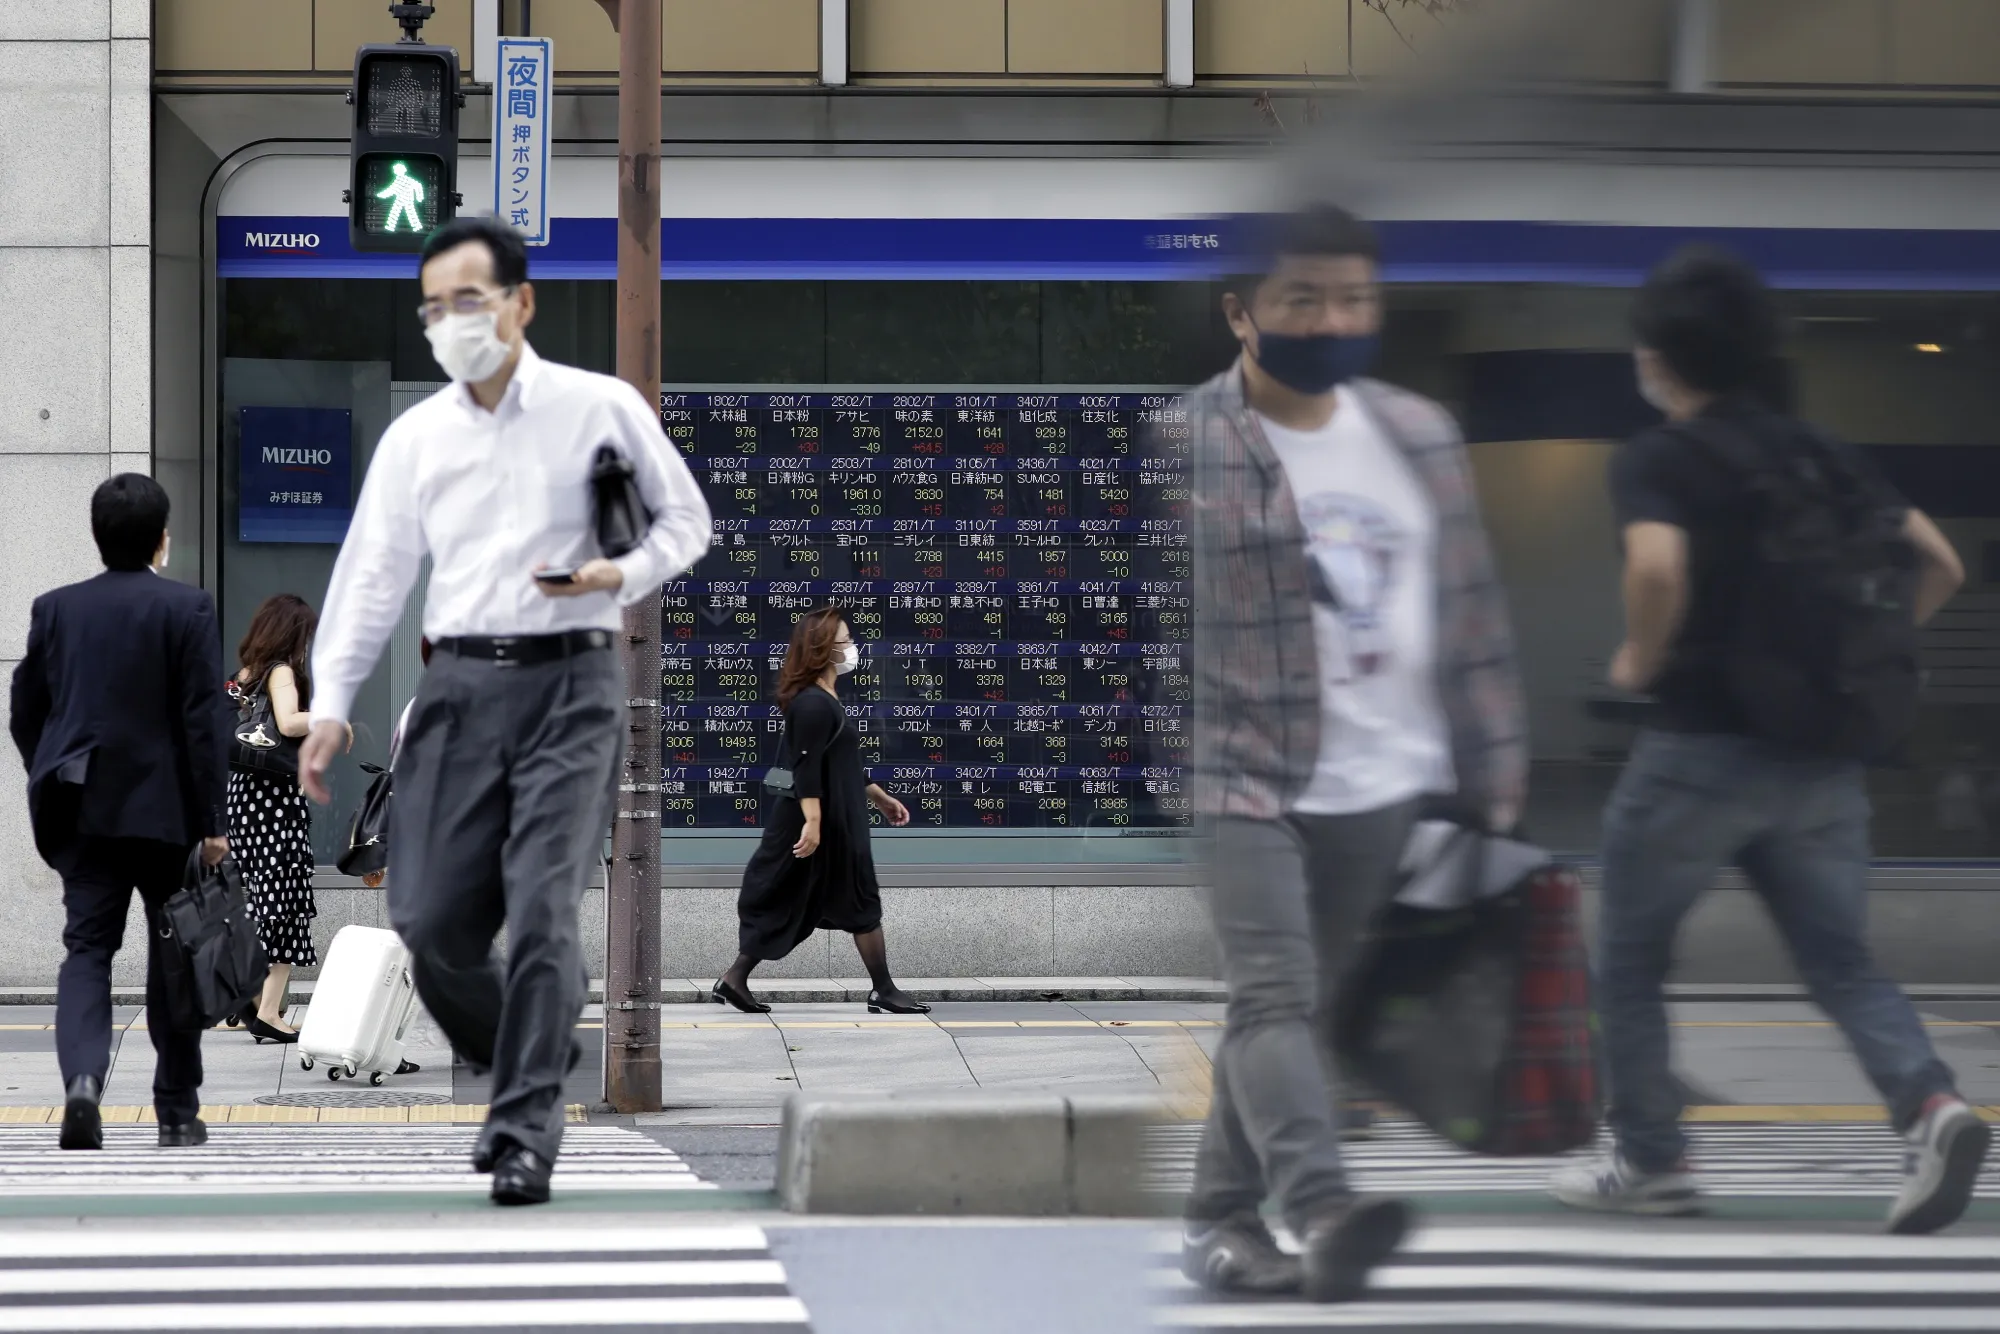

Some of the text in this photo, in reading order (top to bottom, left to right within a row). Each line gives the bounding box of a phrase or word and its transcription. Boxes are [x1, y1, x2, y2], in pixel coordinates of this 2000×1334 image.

[245, 232, 320, 248] MIZUHO
[707, 395, 749, 406] 1802/T
[769, 395, 811, 406] 2001/T
[831, 395, 873, 406] 2502/T
[893, 395, 935, 406] 2802/T
[955, 396, 996, 407] 3101/T
[1017, 396, 1058, 407] 3407/T
[1079, 396, 1120, 407] 4005/T
[1140, 396, 1181, 408] 4091/T
[709, 409, 747, 421] 大林組
[773, 410, 809, 422] 日本粉
[835, 411, 869, 422] アサヒ
[895, 410, 933, 422] 味の素
[957, 410, 995, 422] 東洋紡
[1019, 410, 1057, 422] 旭化成
[1080, 410, 1118, 422] 住友化
[666, 427, 693, 437] 1687
[735, 427, 756, 437] 976
[790, 427, 818, 437] 1728
[852, 427, 880, 437] 3776
[904, 427, 943, 437] 2152.0
[976, 427, 1001, 438] 1641
[1035, 427, 1065, 438] 929.9
[1106, 428, 1127, 438] 365
[261, 446, 333, 464] MIZUHO
[707, 457, 749, 468] 1803/T
[769, 457, 811, 468] 2002/T
[831, 457, 873, 468] 2503/T
[893, 457, 935, 468] 2810/T
[955, 458, 997, 468] 3105/T
[1017, 458, 1058, 469] 3436/T
[1078, 458, 1120, 469] 4021/T
[1140, 458, 1182, 469] 4151/T
[709, 471, 747, 483] 清水建
[768, 472, 814, 484] 日清粉G
[828, 472, 876, 484] キリンHD
[1017, 474, 1059, 483] SUMCO
[1082, 472, 1118, 484] 日産化
[269, 491, 323, 504] みずほ証券
[738, 489, 756, 499] 805
[790, 489, 817, 499] 1704
[843, 489, 881, 499] 1961.0
[914, 489, 943, 499] 3630
[983, 489, 1003, 500] 754
[1038, 489, 1062, 499] 1481
[1100, 489, 1128, 499] 5420
[1161, 489, 1189, 499] 2892
[769, 519, 811, 530] 2267/T
[831, 519, 873, 530] 2531/T
[893, 519, 935, 530] 2871/T
[955, 519, 997, 530] 3110/T
[1017, 520, 1058, 530] 3591/T
[1078, 520, 1120, 530] 4023/T
[1140, 520, 1182, 530] 4183/T
[769, 534, 810, 546] ヤクルト
[836, 534, 867, 546] 宝HD
[893, 535, 935, 546] ニチレイ
[959, 534, 995, 546] 日東紡
[1083, 534, 1115, 546] クレハ
[727, 551, 756, 561] 1295
[790, 551, 819, 561] 5780
[852, 551, 877, 561] 1111
[914, 551, 942, 561] 2788
[976, 551, 1003, 561] 4415
[1038, 551, 1065, 561] 1957
[1100, 551, 1128, 561] 5000
[1161, 551, 1189, 561] 2618
[707, 581, 749, 592] 1893/T
[769, 581, 811, 592] 2269/T
[831, 581, 873, 592] 2587/T
[893, 581, 934, 592] 2897/T
[955, 581, 997, 592] 3289/T
[1017, 581, 1058, 592] 3861/T
[1078, 581, 1120, 592] 4041/T
[1140, 581, 1182, 592] 4188/T
[709, 595, 747, 608] 五洋建
[768, 596, 812, 608] 明治HD
[889, 596, 941, 608] 日清食HD
[949, 596, 1002, 608] 東急不HD
[1018, 596, 1059, 608] 王子HD
[1082, 596, 1118, 608] 日曹達
[666, 613, 693, 623] 1603
[735, 613, 755, 623] 684
[852, 613, 881, 623] 3960
[914, 613, 943, 623] 9930
[983, 613, 1001, 623] 481
[1045, 613, 1065, 623] 493
[1100, 613, 1127, 623] 3165
[1158, 613, 1185, 623] 656.1
[707, 643, 749, 654] 1925/T
[893, 643, 935, 654] 2914/T
[955, 643, 996, 654] 3382/T
[1017, 643, 1058, 654] 3863/T
[1078, 643, 1120, 654] 4042/T
[1140, 643, 1182, 654] 4208/T
[1020, 657, 1057, 669] 日本紙
[1082, 658, 1116, 669] 東ソー
[663, 675, 693, 685] 602.8
[718, 675, 757, 685] 2872.0
[852, 675, 880, 685] 1614
[904, 675, 942, 685] 1973.0
[976, 675, 1003, 685] 3378
[1038, 675, 1065, 685] 1329
[1100, 675, 1127, 685] 1759
[1161, 675, 1189, 685] 1894
[707, 705, 749, 716] 1928/T
[893, 705, 935, 716] 3086/T
[955, 705, 997, 716] 3401/T
[1017, 705, 1058, 716] 3865/T
[1078, 705, 1120, 716] 4061/T
[1140, 705, 1182, 716] 4272/T
[1083, 719, 1115, 731] デンカ
[666, 737, 693, 747] 3005
[718, 737, 755, 747] 1949.5
[921, 737, 943, 747] 730
[976, 737, 1003, 747] 1664
[1045, 737, 1065, 747] 368
[1100, 737, 1127, 747] 3145
[707, 767, 749, 778] 1942/T
[893, 767, 935, 778] 3099/T
[955, 767, 997, 778] 3402/T
[1017, 767, 1058, 778] 4004/T
[1079, 767, 1120, 777] 4063/T
[1140, 767, 1182, 777] 4324/T
[708, 781, 746, 793] 関電工
[1019, 781, 1056, 793] 昭電工
[1080, 781, 1118, 793] 信越化
[666, 799, 693, 809] 3675
[735, 799, 756, 809] 870
[921, 799, 942, 809] 564
[973, 799, 1003, 809] 496.6
[1038, 798, 1065, 809] 2089
[1093, 798, 1127, 808] 13985
